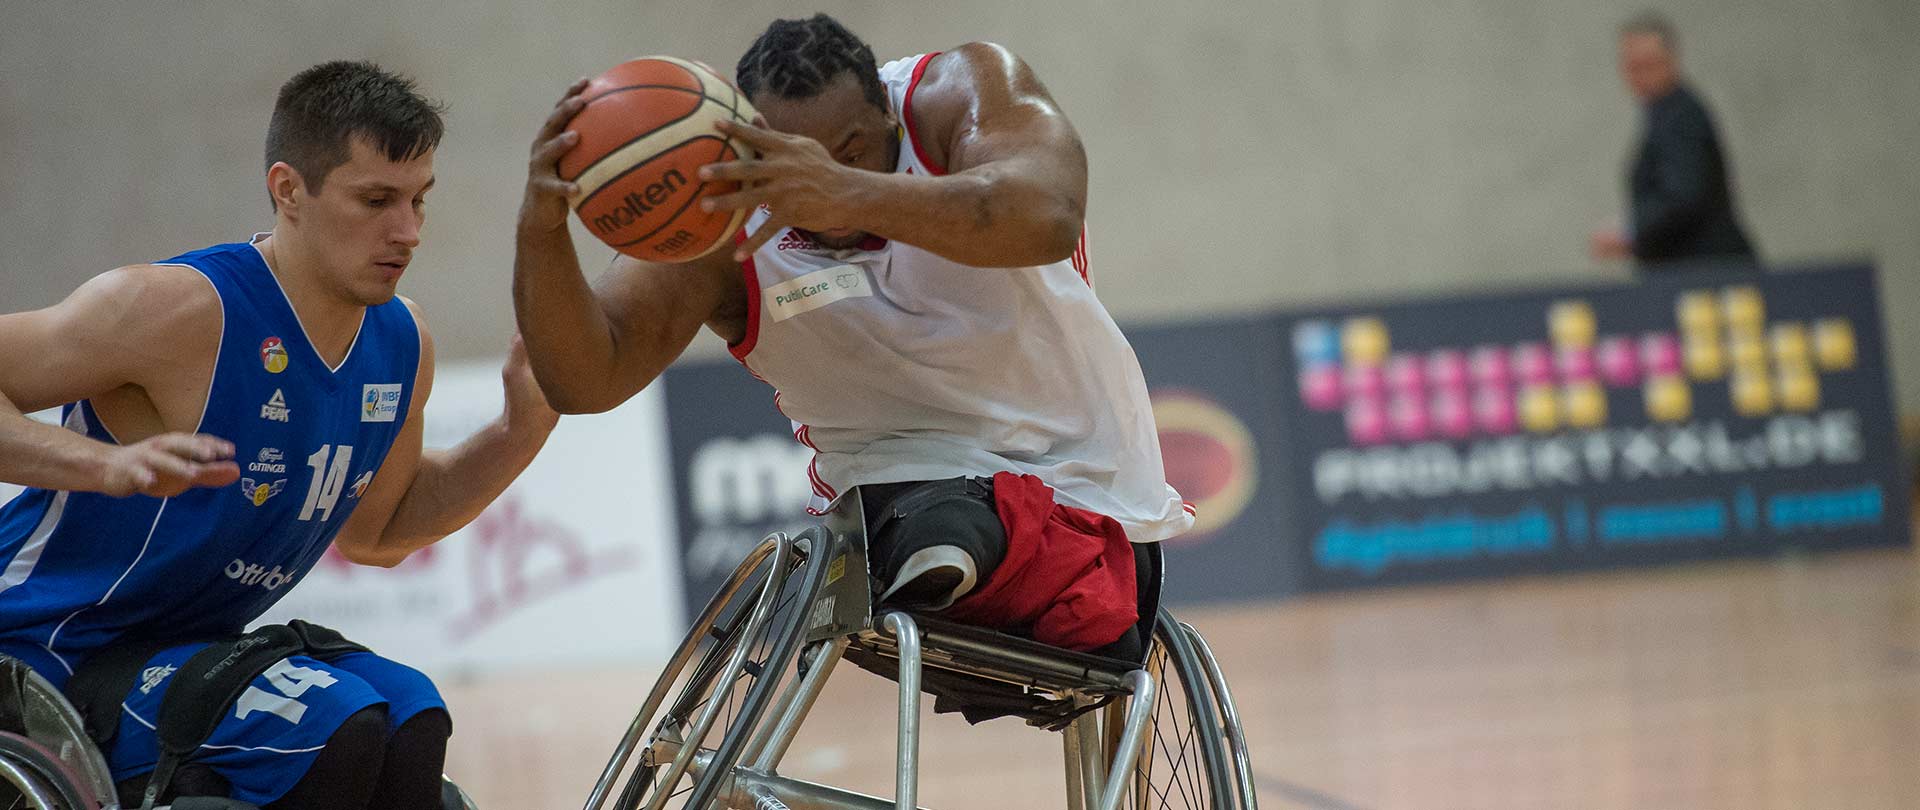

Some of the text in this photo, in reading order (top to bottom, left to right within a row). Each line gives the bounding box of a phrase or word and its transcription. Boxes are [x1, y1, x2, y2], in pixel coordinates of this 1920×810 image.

[593, 167, 688, 235] molten
[653, 229, 695, 257] FIBA
[777, 240, 820, 251] adidas
[776, 280, 829, 307] PubliCare
[260, 404, 291, 423] PEAK
[298, 444, 353, 522] 14
[139, 663, 178, 695] PEAK
[235, 657, 339, 725] 14
